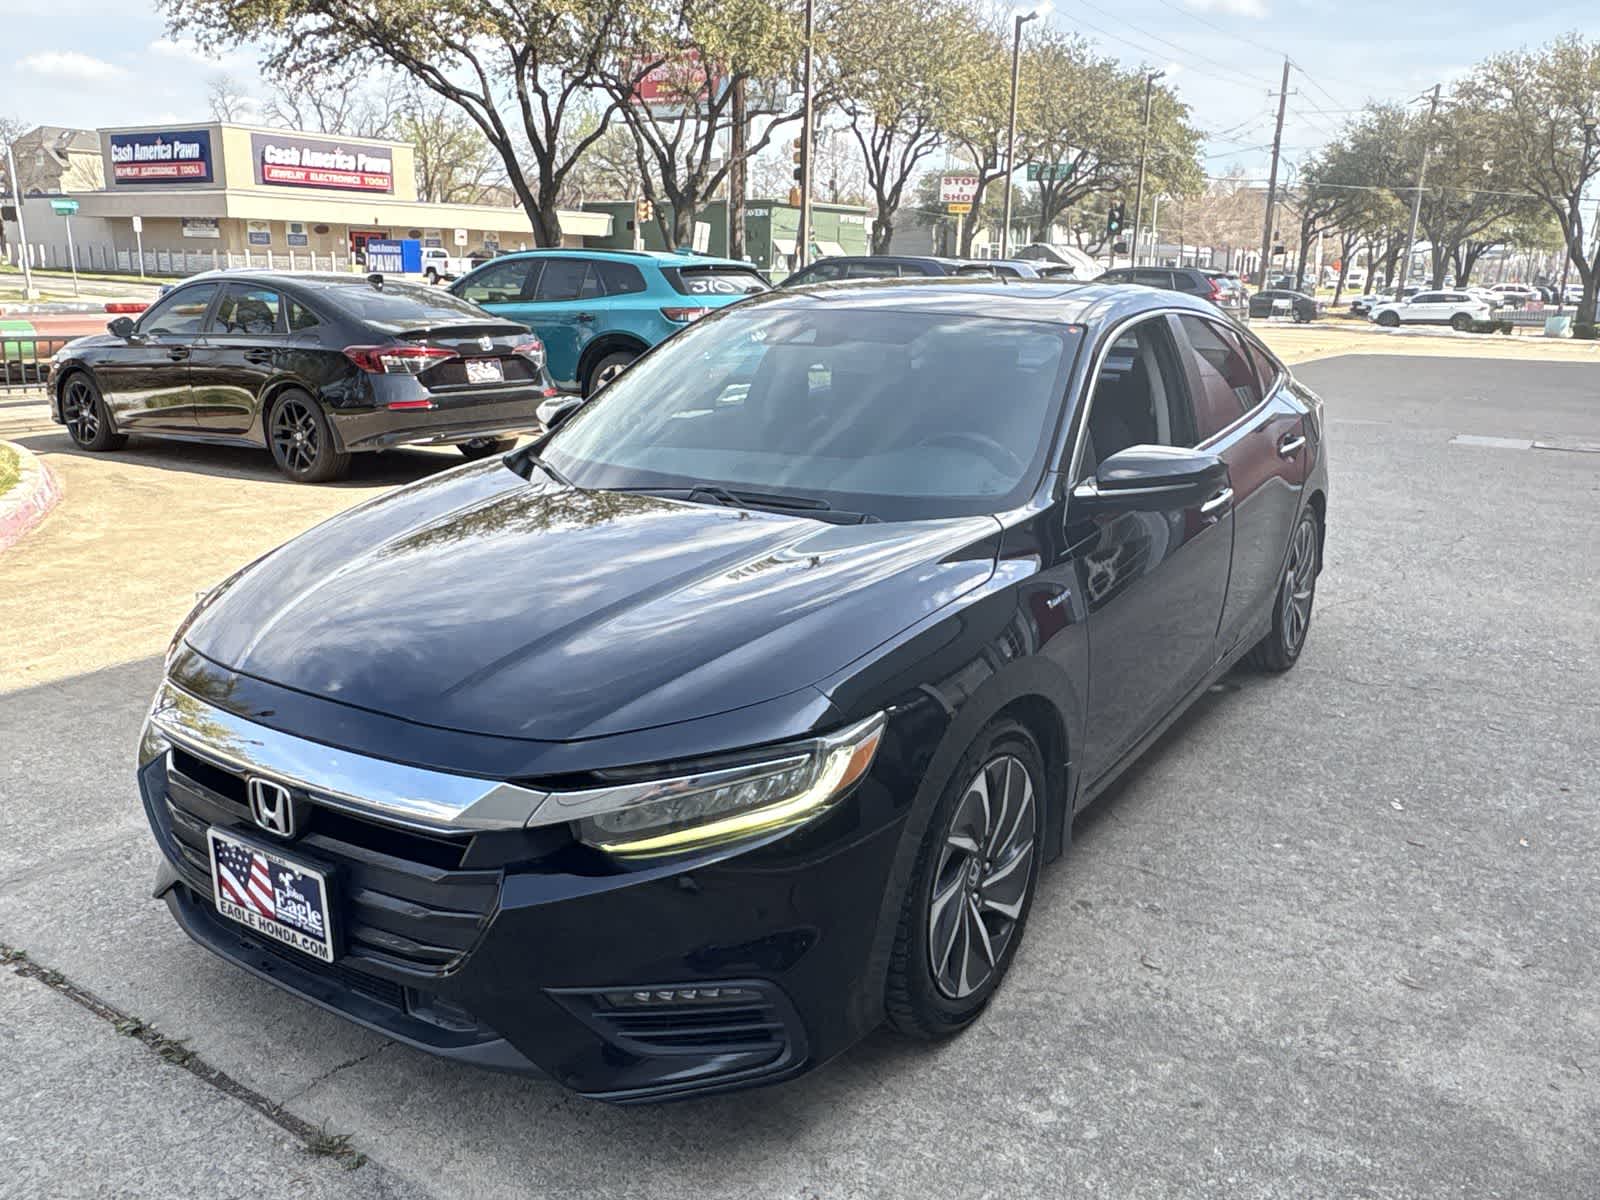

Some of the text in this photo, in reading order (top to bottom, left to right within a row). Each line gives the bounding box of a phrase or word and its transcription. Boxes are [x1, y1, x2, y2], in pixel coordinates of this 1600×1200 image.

[111, 140, 200, 162] Cash America Pawn
[265, 144, 391, 173] Cash America Pawn
[269, 169, 388, 186] JEWELRY ELECTRONICS TOOLS
[744, 208, 769, 217] AVERN
[369, 254, 403, 271] PAWN
[274, 887, 322, 926] Eagle
[220, 901, 256, 926] EAGLE
[258, 918, 329, 959] HONDA.COM
